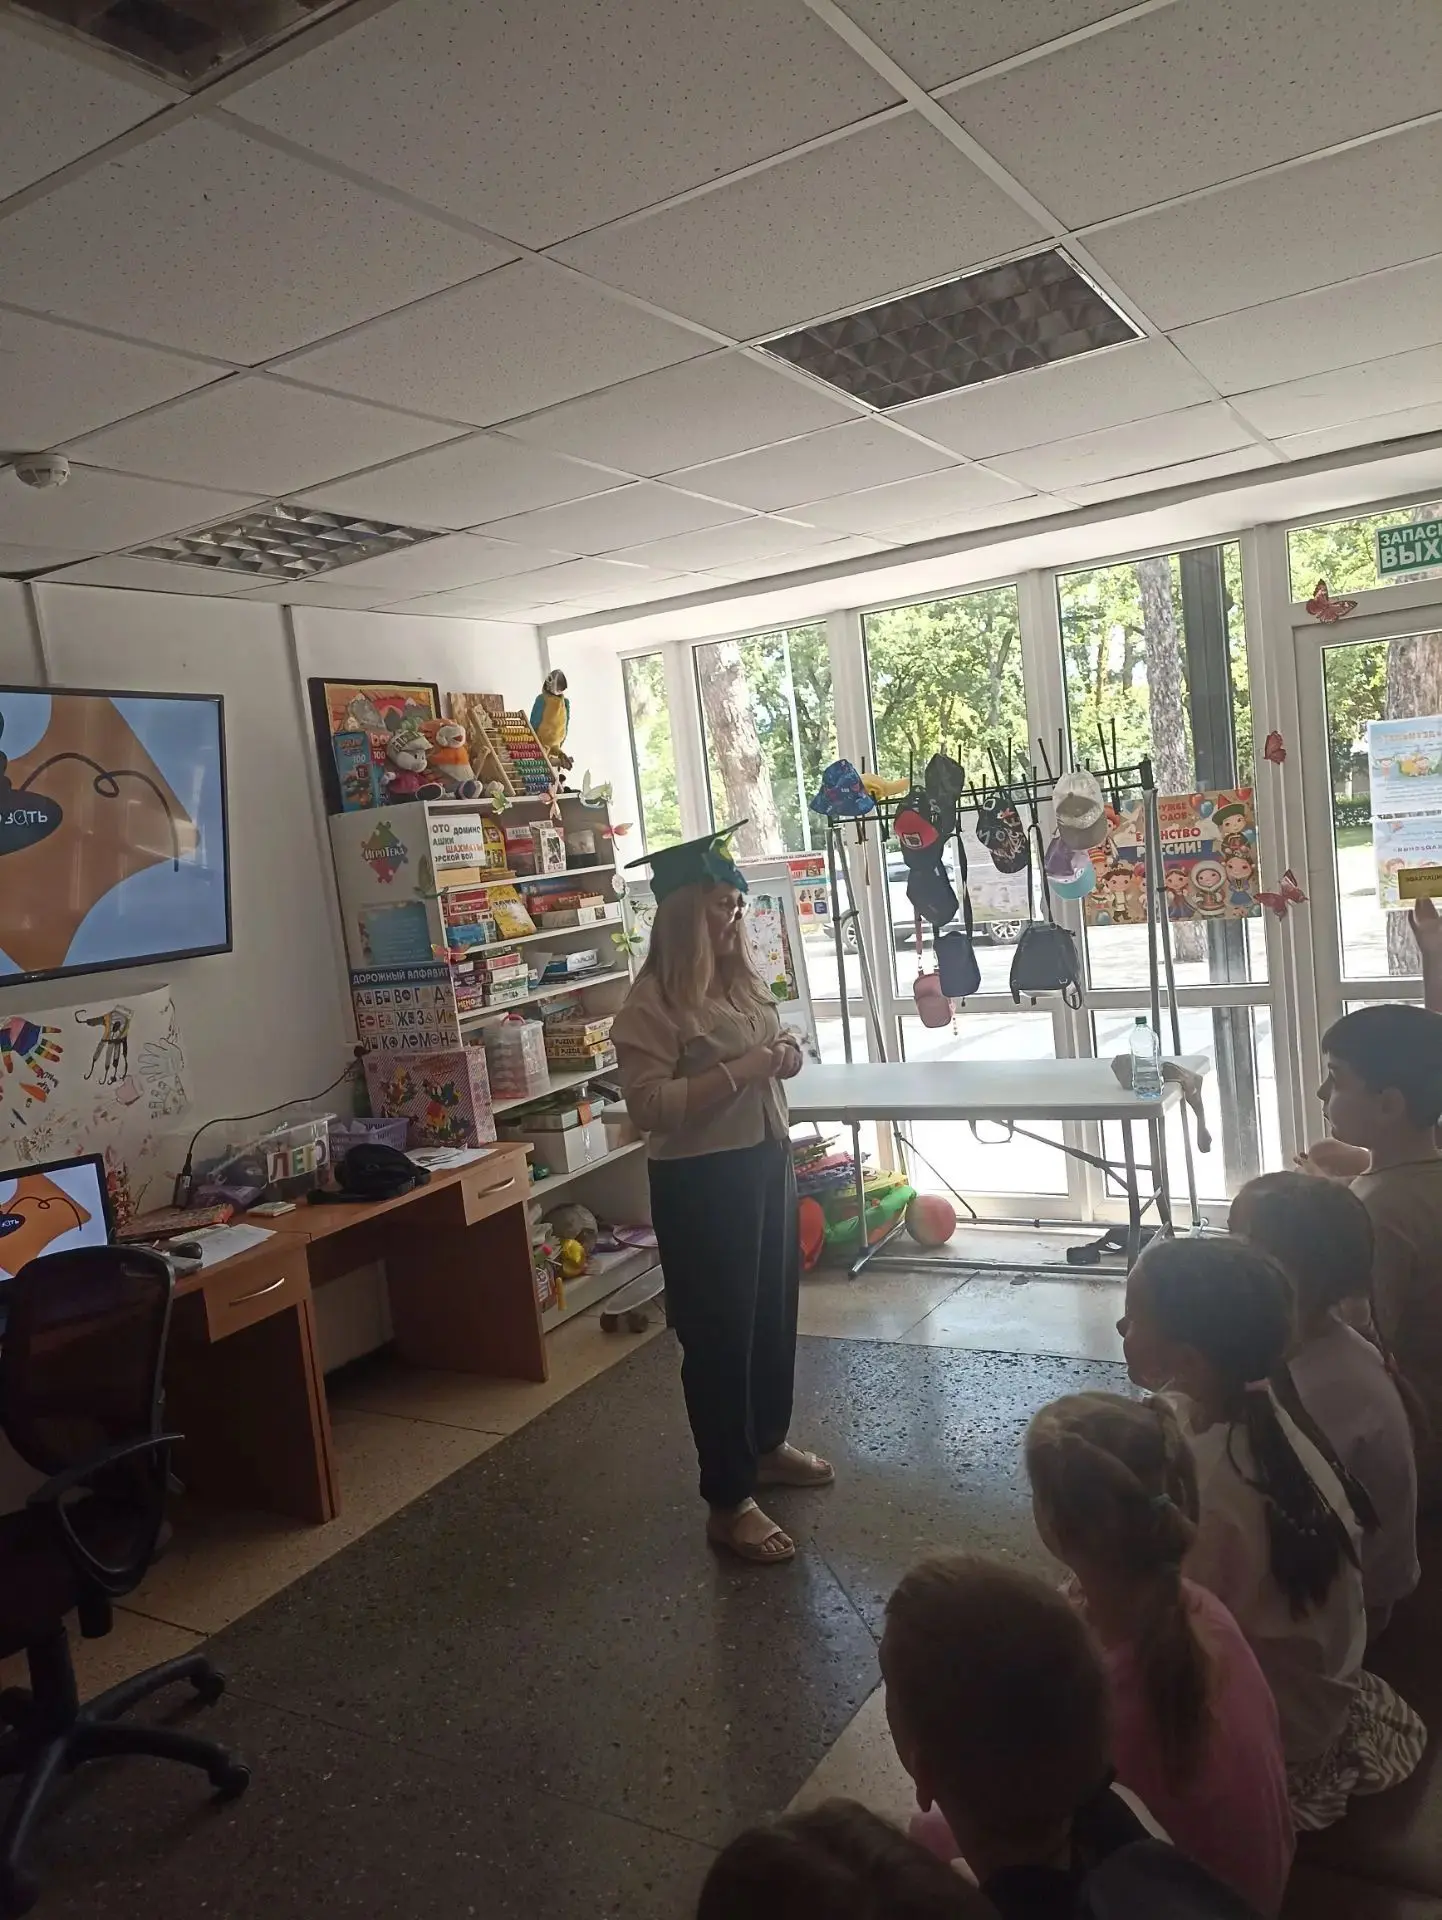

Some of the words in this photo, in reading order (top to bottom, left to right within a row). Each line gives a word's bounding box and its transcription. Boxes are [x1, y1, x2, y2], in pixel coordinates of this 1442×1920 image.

[1380, 523, 1442, 546] ЗАПАС
[1380, 538, 1442, 569] ВЫХ
[1158, 801, 1188, 812] УЖБЕ
[1136, 827, 1201, 843] ЕНСТВО
[353, 970, 406, 985] ДОРОЖНЫЙ
[408, 968, 449, 980] АЛФАВИТ
[356, 991, 365, 1006] А
[375, 990, 384, 1005] Б
[394, 988, 402, 1003] В
[414, 987, 420, 1003] Г
[435, 986, 446, 1003] Д
[458, 998, 476, 1009] MEMO
[358, 1014, 365, 1028] Е
[397, 1011, 408, 1026] Ж
[417, 1010, 424, 1025] З
[437, 1009, 446, 1023] И
[381, 1035, 389, 1050] К
[402, 1034, 410, 1049] Л
[419, 1032, 430, 1047] М
[440, 1031, 449, 1047] Н
